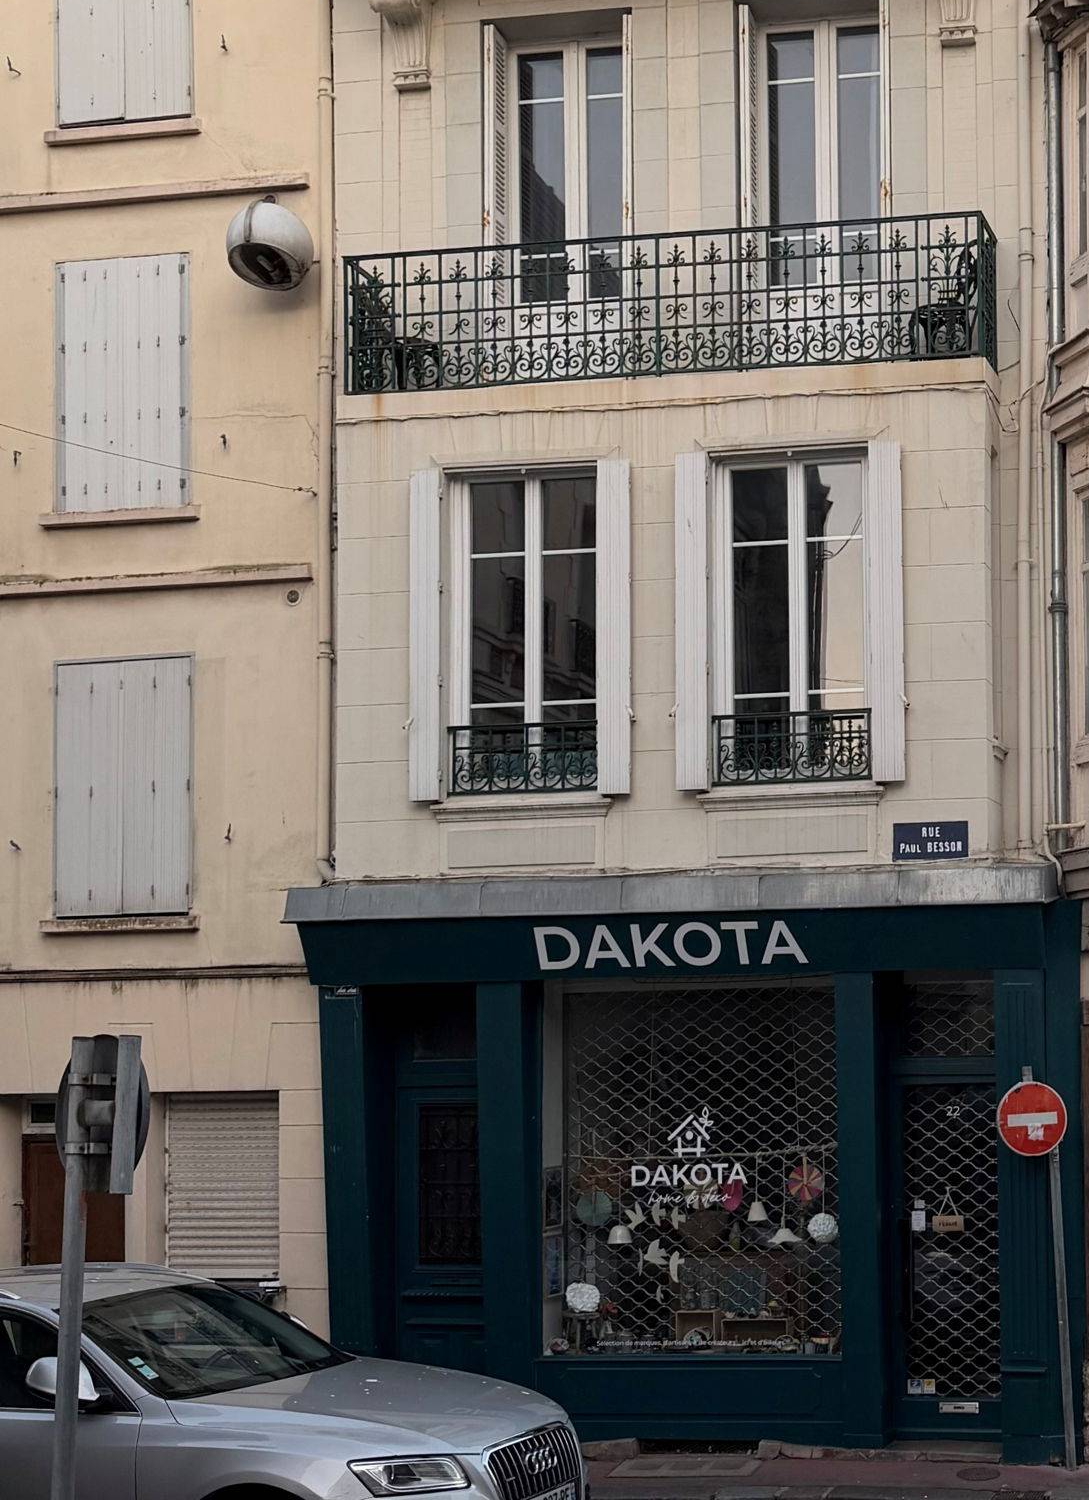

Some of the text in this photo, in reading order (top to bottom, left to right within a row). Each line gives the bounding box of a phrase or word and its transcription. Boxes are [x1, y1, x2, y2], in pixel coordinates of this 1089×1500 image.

[922, 826, 941, 838] RUE
[900, 841, 962, 854] PAUL BESSON
[533, 920, 810, 971] DAKOTA
[946, 1106, 961, 1117] 22
[631, 1162, 748, 1187] DAKOTA
[648, 1190, 684, 1205] home
